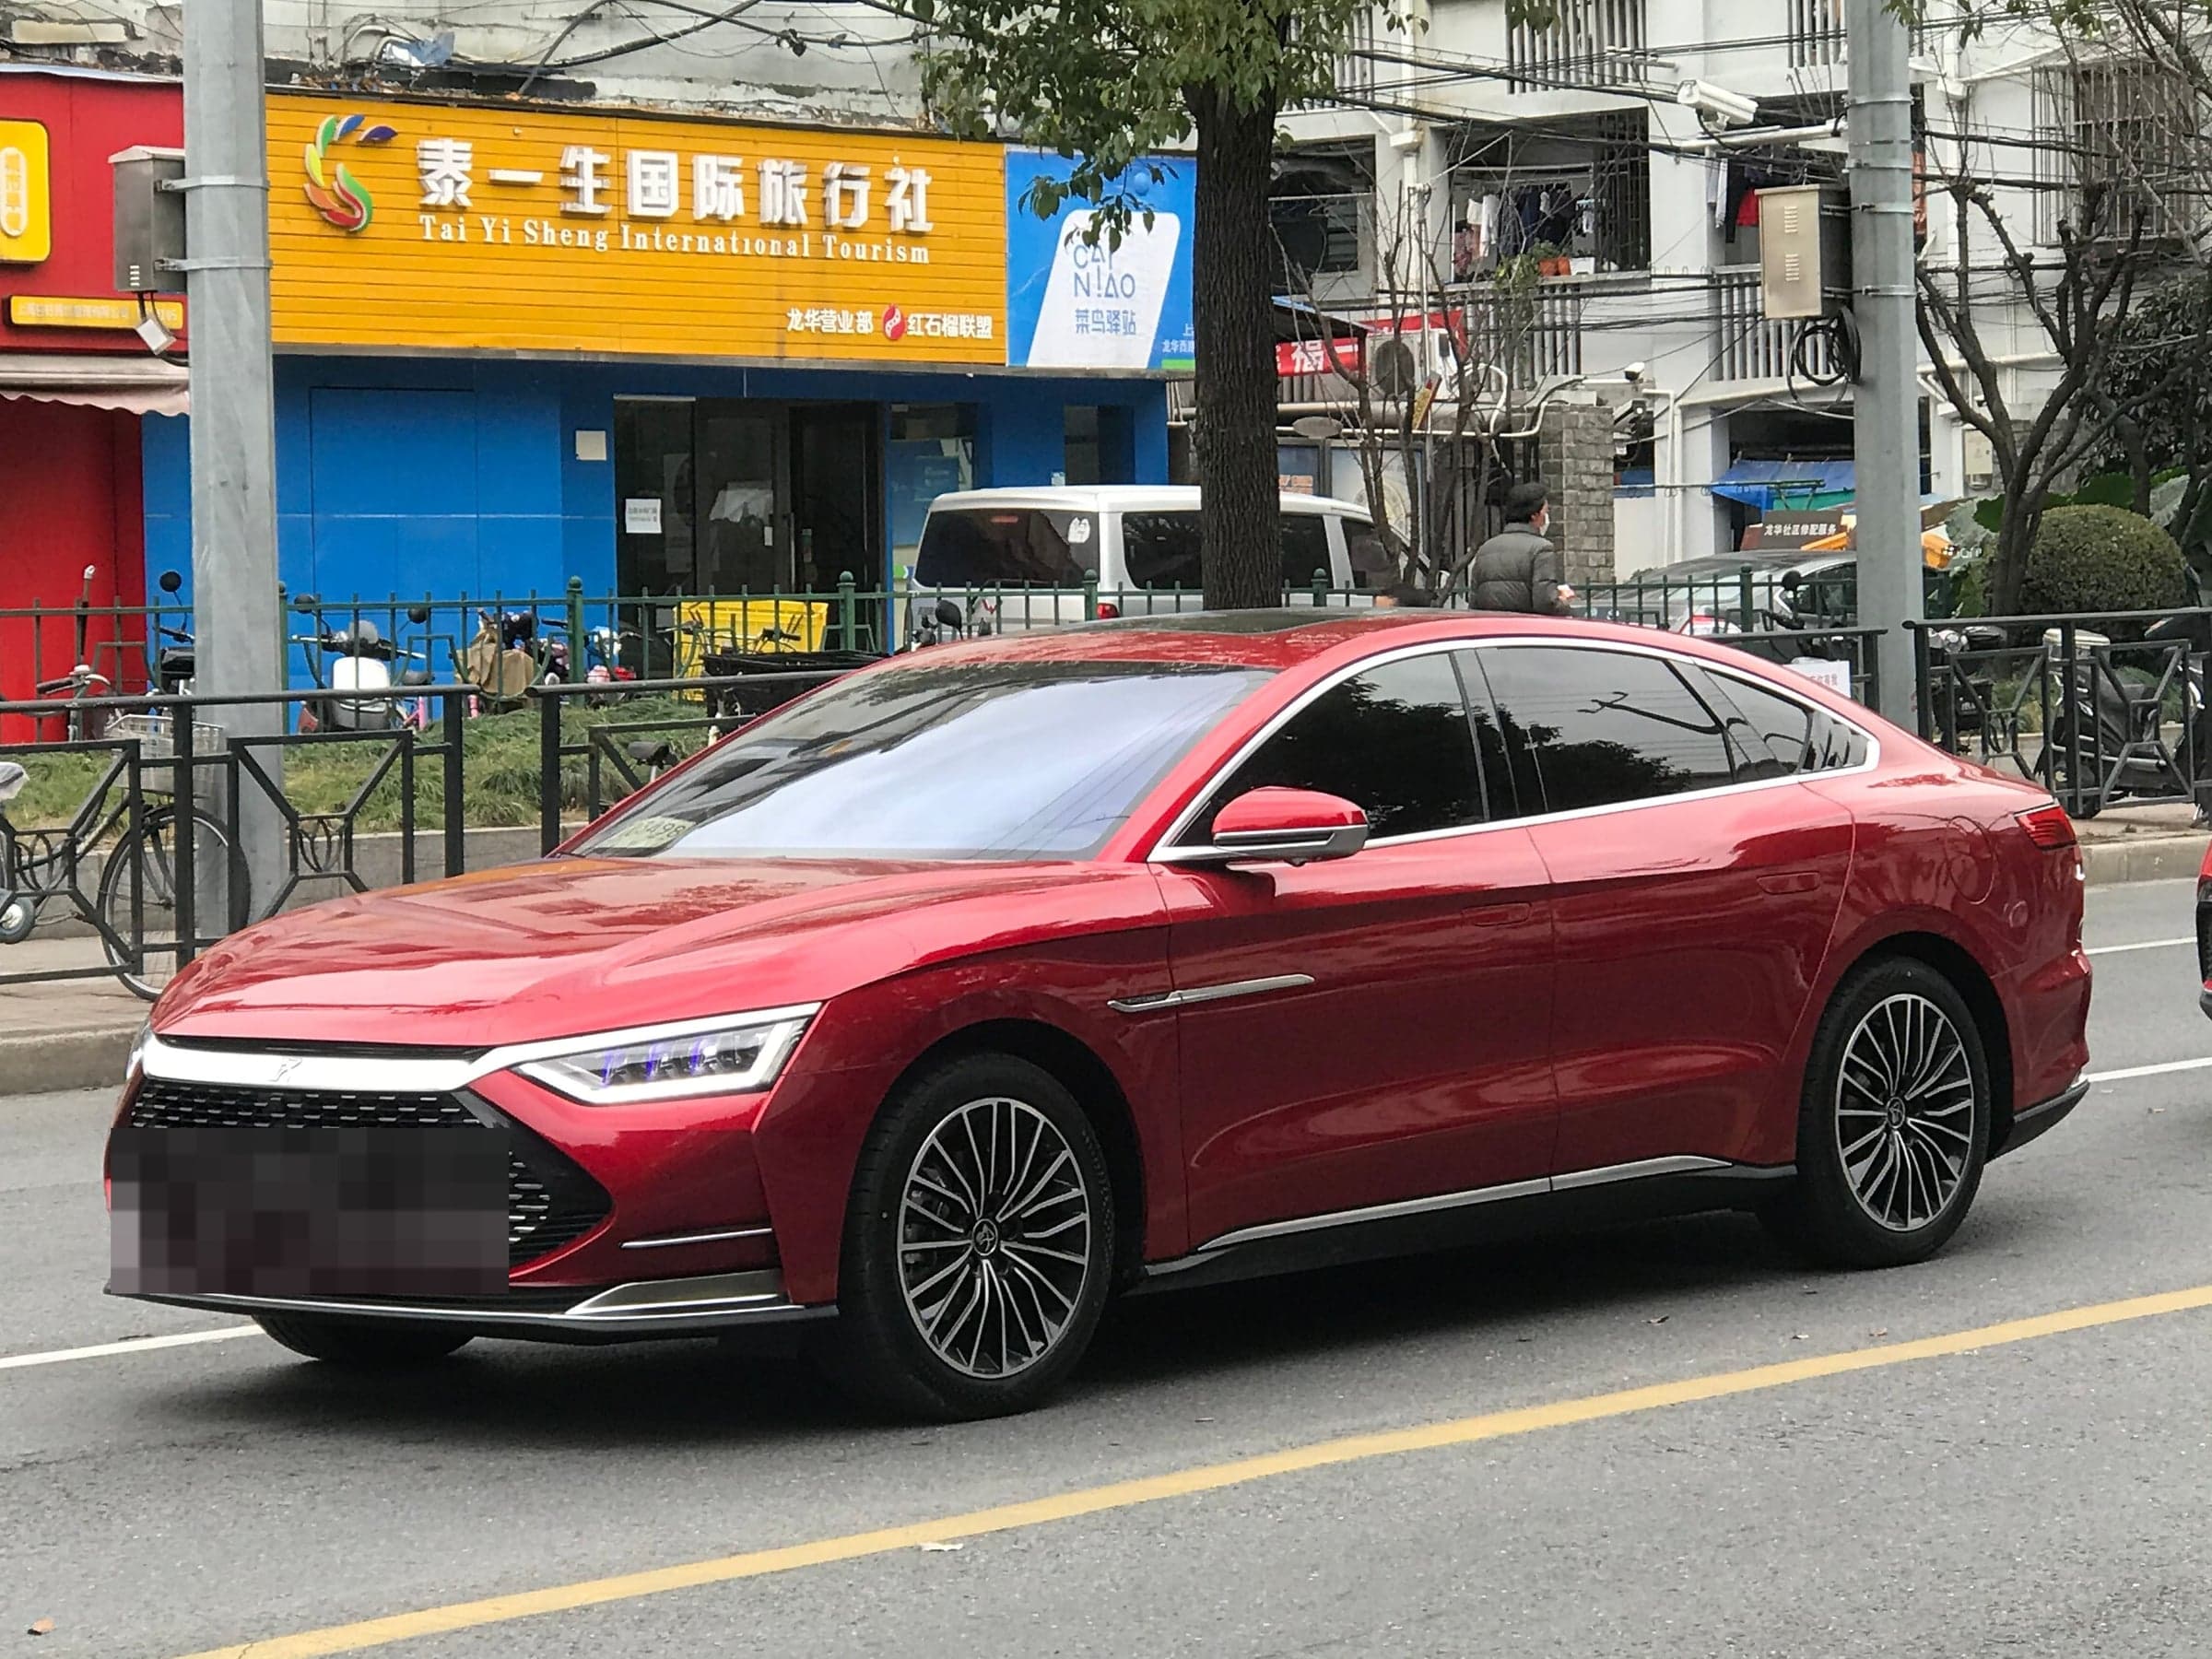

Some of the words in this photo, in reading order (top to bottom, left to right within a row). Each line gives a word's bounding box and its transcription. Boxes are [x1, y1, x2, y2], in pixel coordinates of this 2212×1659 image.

[417, 137, 934, 233] 泰一生国际旅行社
[418, 215, 467, 241] Tai
[480, 217, 512, 244] Yi
[523, 219, 609, 252] Sheng
[620, 223, 810, 259] International
[822, 234, 930, 265] Tourism
[786, 307, 874, 335] 龙华营业部
[906, 312, 994, 340] 红石榴联盟
[1075, 308, 1136, 336] 菜鸟驿站
